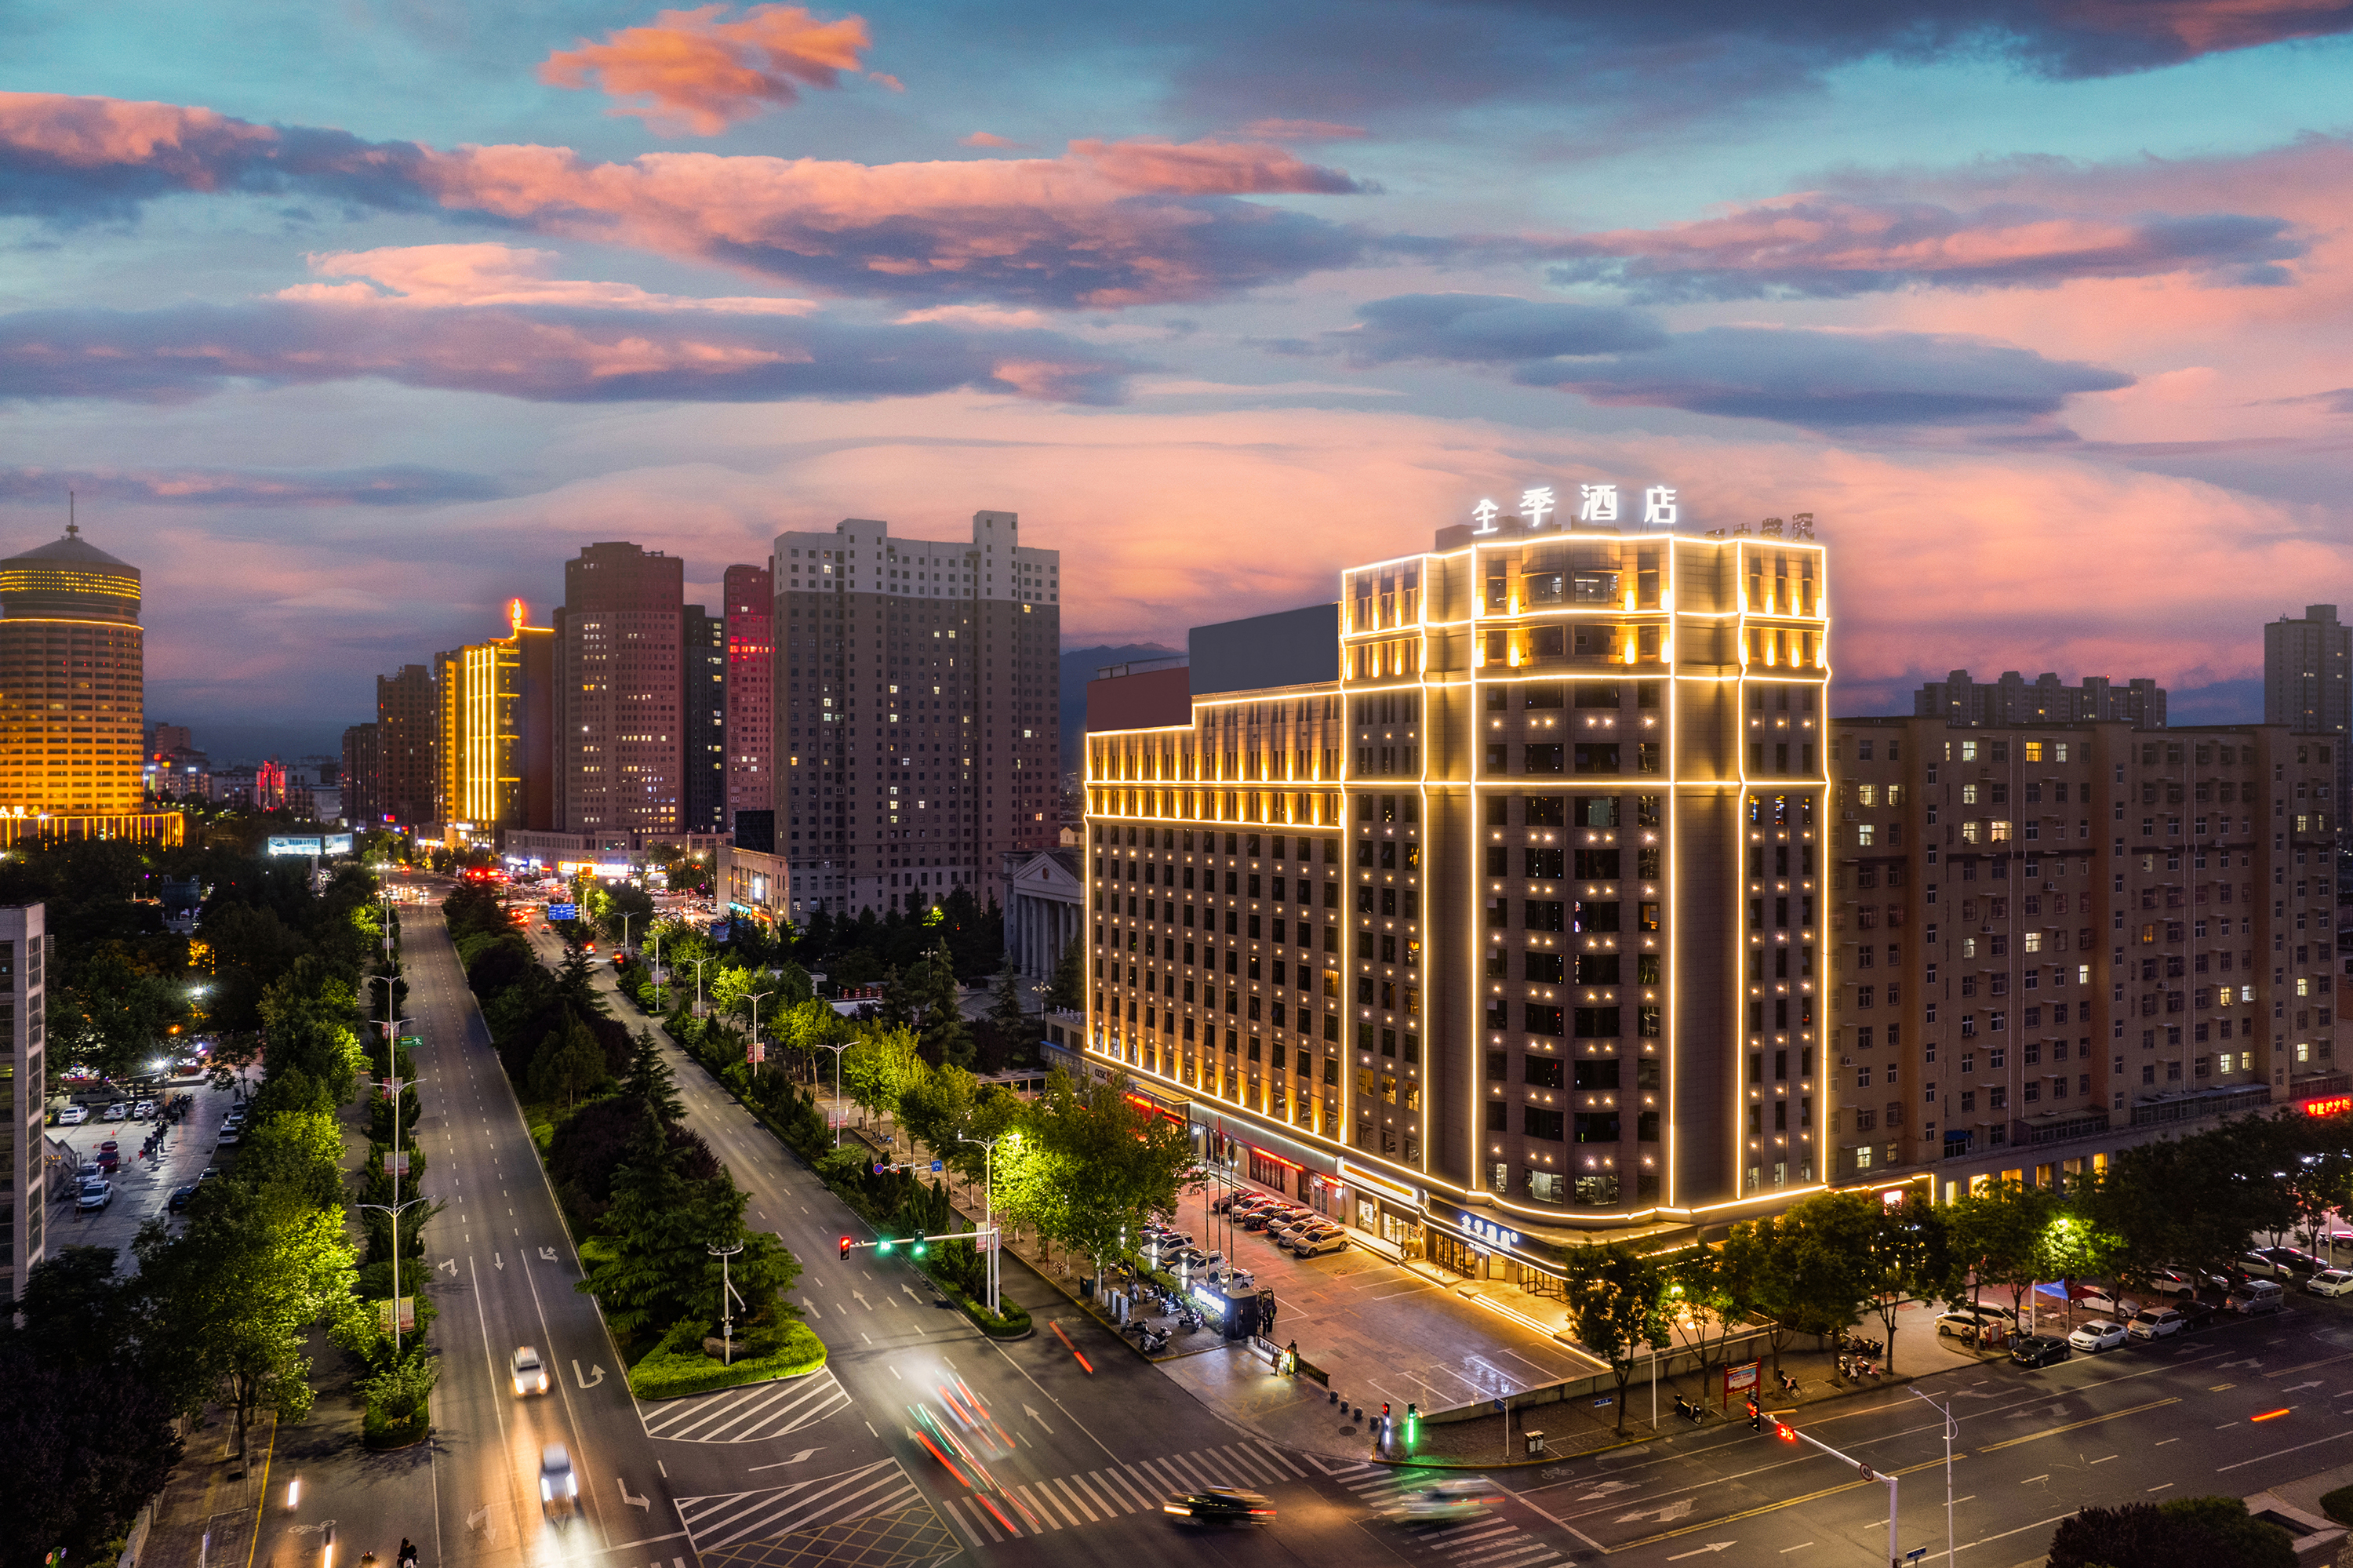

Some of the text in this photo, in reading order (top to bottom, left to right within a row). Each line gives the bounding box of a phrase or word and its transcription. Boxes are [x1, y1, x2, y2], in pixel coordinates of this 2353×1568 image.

[1472, 485, 1677, 535] 全季酒店
[1863, 1468, 1871, 1477] 40
